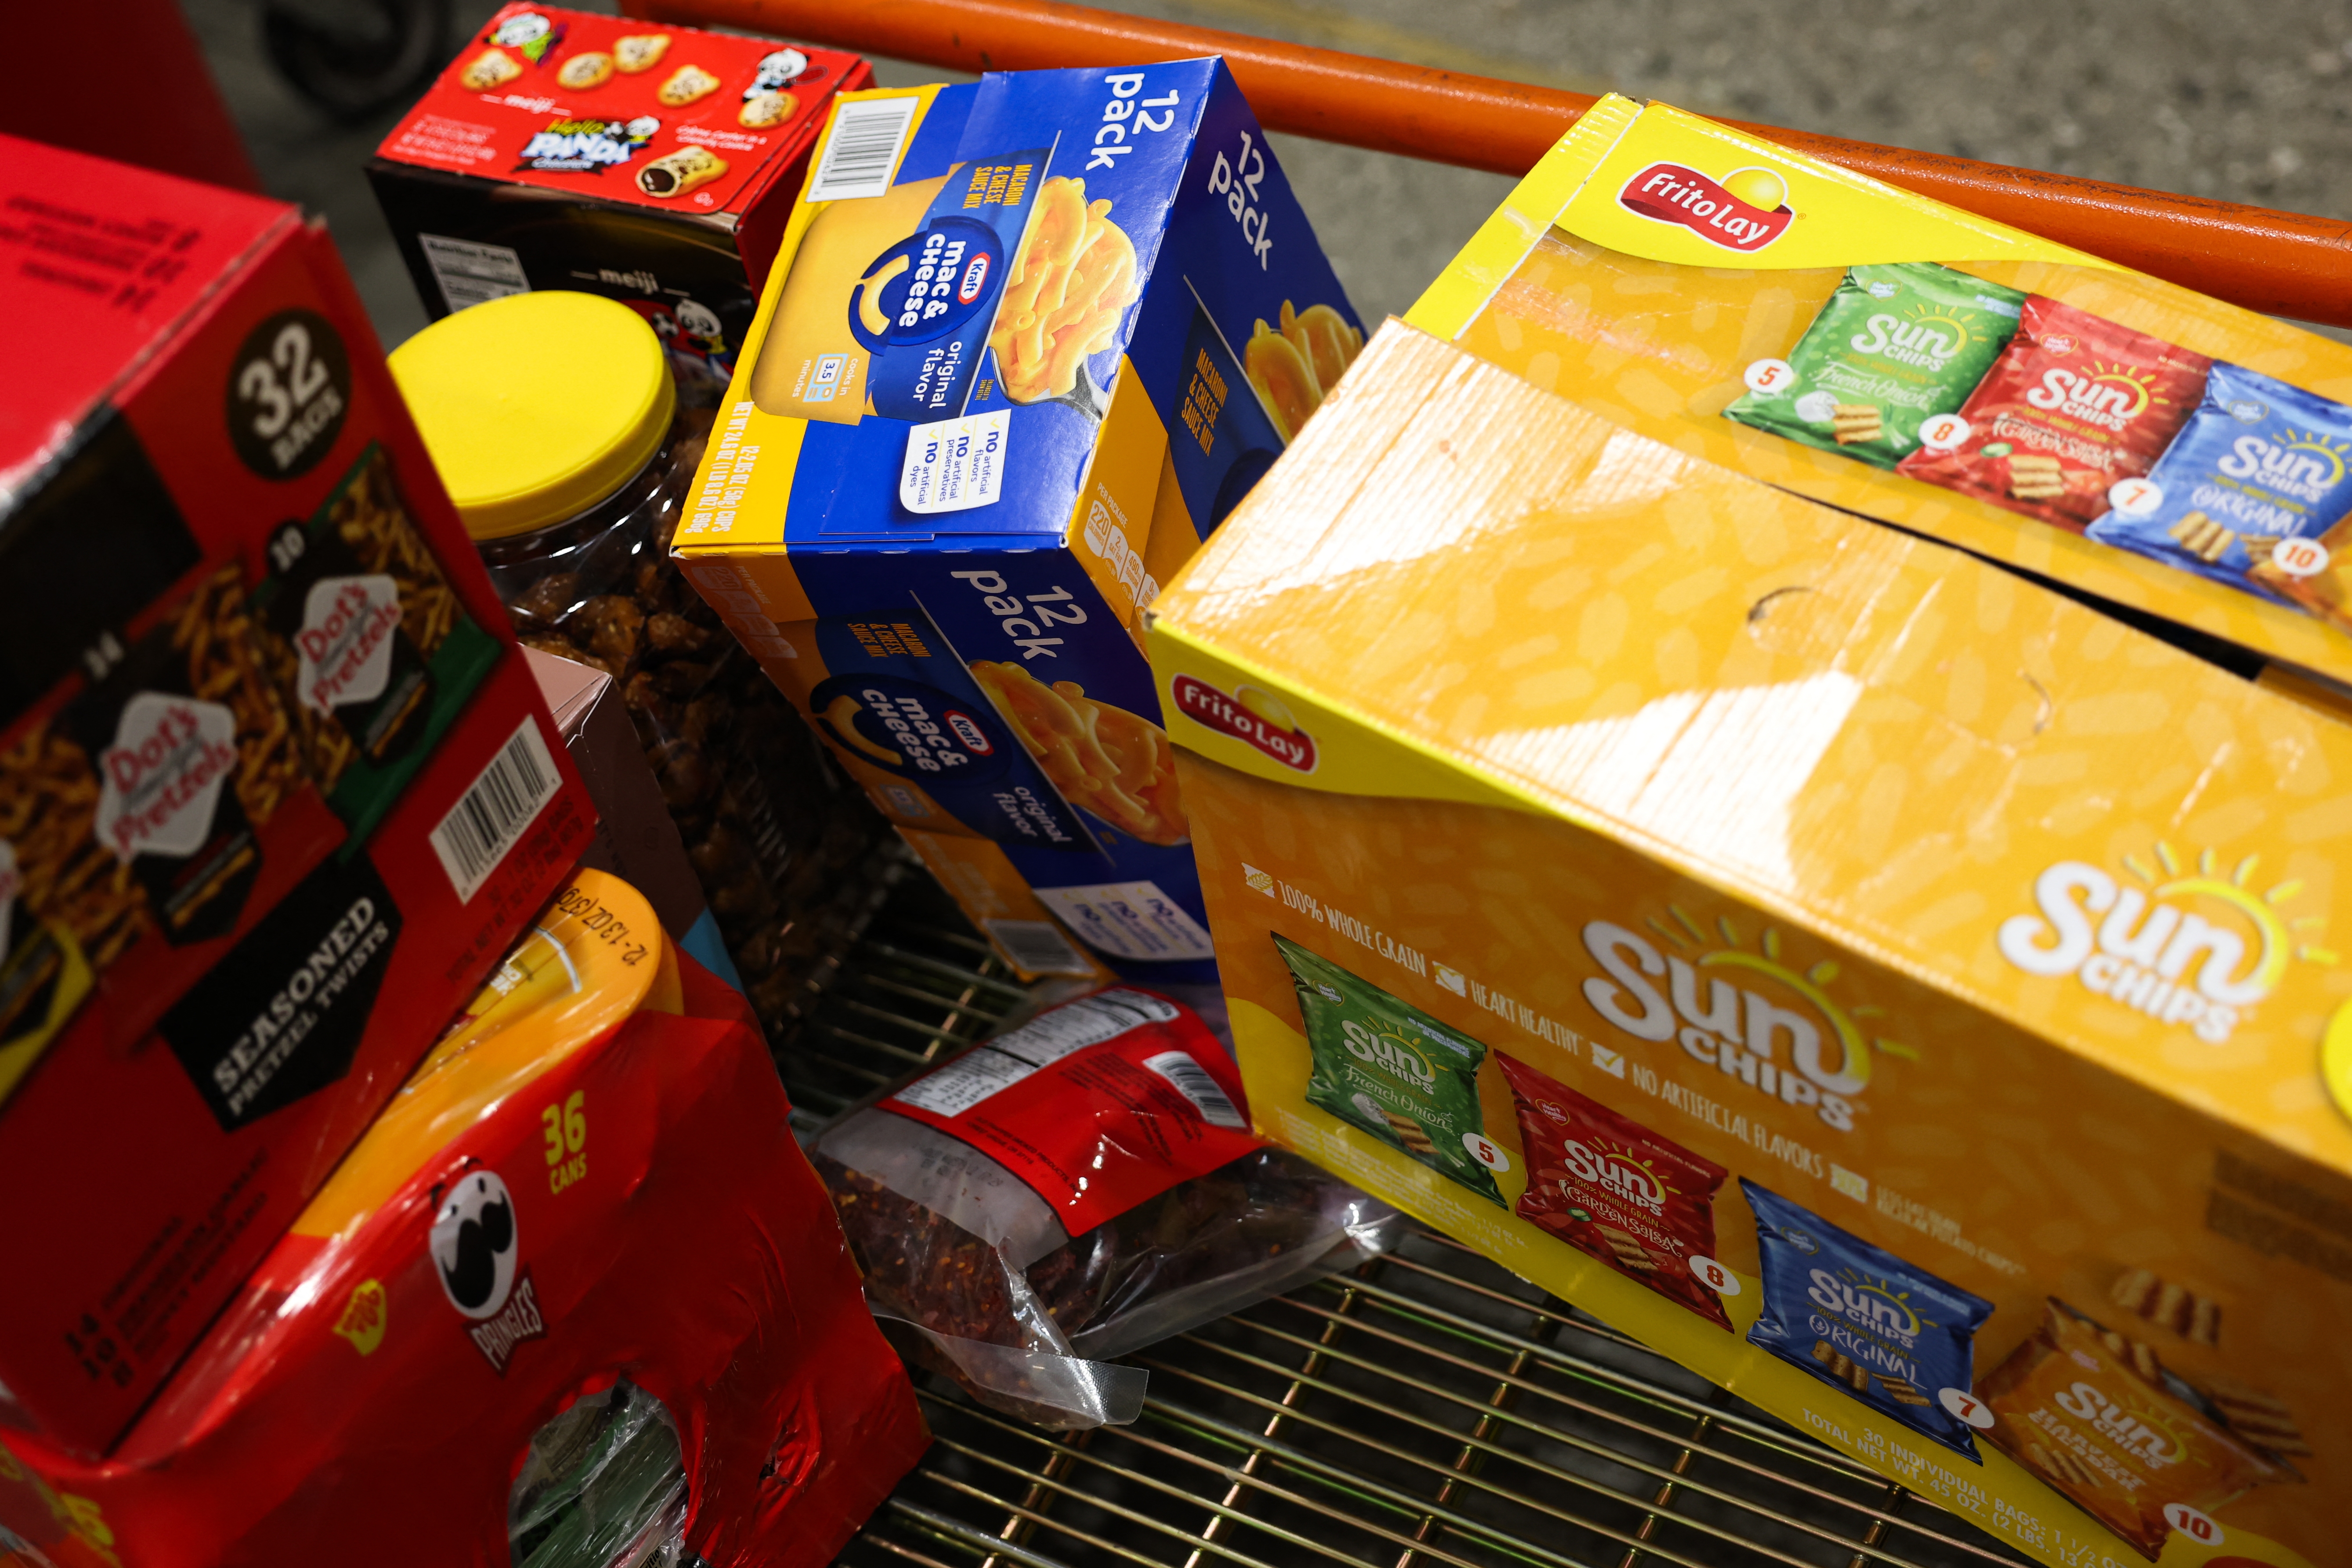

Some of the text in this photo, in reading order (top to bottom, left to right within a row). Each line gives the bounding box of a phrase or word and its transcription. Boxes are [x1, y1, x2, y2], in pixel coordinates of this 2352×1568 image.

[503, 94, 556, 114] meiji
[546, 118, 605, 134] Hello
[1086, 73, 1145, 171] pack
[1132, 89, 1180, 135] 12
[520, 132, 631, 164] PANDA
[1239, 130, 1265, 202] 12
[962, 166, 993, 209] SAUCE MIX
[983, 174, 1009, 204] CHEESE
[1002, 164, 1033, 206] MACARONI
[1641, 173, 1769, 245] Frito Lay
[1208, 150, 1273, 272] pack
[598, 268, 659, 294] meiji
[923, 241, 966, 320] mac &
[964, 263, 984, 293] Kraft
[1850, 313, 1967, 359] Sun
[1883, 345, 1945, 372] CHIPS
[238, 322, 328, 435] 32
[792, 359, 811, 397] minutes
[822, 362, 835, 379] 3.5
[839, 358, 859, 396] cooks in
[913, 348, 944, 401] flavor
[929, 341, 961, 408] original
[1196, 347, 1228, 407] MACARONI
[1758, 367, 1779, 385] 5
[1811, 361, 1929, 410] French Onion
[2027, 368, 2143, 419] Sun
[726, 417, 748, 430] WT
[732, 401, 755, 417] NET
[1189, 374, 1220, 429] & CHEESE
[2062, 401, 2127, 431] CHIPS
[720, 431, 743, 449] 24.6
[1181, 399, 1215, 457] SAUCE MIX
[1934, 421, 1954, 441] 8
[708, 470, 729, 481] LB
[715, 450, 736, 461] OZ
[910, 466, 921, 488] dyes
[918, 441, 939, 505] no artificial
[939, 439, 955, 502] preservatives
[949, 436, 970, 499] no artificial
[971, 449, 983, 482] flavors
[979, 431, 1000, 495] no artificial
[2218, 436, 2335, 489] Sun
[694, 496, 719, 511] OZ)
[703, 482, 724, 495] 8.6
[711, 445, 760, 532] 12-2.05 OZ (58g) CUPS
[1097, 482, 1128, 529] PER PACKAGE
[2124, 487, 2147, 506] 7
[2254, 470, 2322, 503] CHIPS
[684, 513, 713, 534] 696g
[1087, 520, 1105, 546] CALORIES
[1091, 504, 1110, 536] 220
[1126, 567, 1139, 589] SODIUM
[2285, 545, 2317, 567] 10
[299, 583, 369, 665] Dot's
[950, 570, 1065, 661] pack
[1026, 585, 1088, 628] 12
[312, 600, 403, 709] Pretzels
[847, 623, 889, 658] SAUCE MIX
[874, 629, 908, 655] CHEESE
[890, 623, 932, 657] MACARONI
[895, 697, 968, 766] mac &
[952, 719, 983, 748] Kraft
[1184, 684, 1305, 765] Frito Lay
[104, 707, 198, 794] Dot's
[113, 739, 233, 855] Pretzels
[994, 793, 1037, 838] flavor
[1015, 787, 1073, 842] original
[1278, 880, 1427, 977] 100% WHOLE GRAIN
[1998, 861, 2275, 1005] Sun
[623, 943, 649, 966] 12
[213, 897, 375, 1094] SEASONED
[229, 920, 388, 1116] PRETZEL TWISTS
[1470, 979, 1579, 1055] HEART HEALTHY
[1582, 920, 1869, 1095] Sun
[2079, 955, 2237, 1043] CHIPS
[1341, 1020, 1436, 1083] Sun
[1344, 1064, 1453, 1131] French Onion
[1353, 1058, 1432, 1106] 100% WHOLE GRAIN
[1376, 1057, 1434, 1095] CHIPS
[1679, 1027, 1854, 1132] CHIPS
[542, 1089, 586, 1165] 36
[1542, 1103, 1560, 1113] Heart
[1632, 1063, 1823, 1178] NO ARTIFICIAL FLAVORS
[550, 1152, 587, 1195] CANS
[1478, 1141, 1494, 1163] 5
[1564, 1139, 1666, 1205] Sun
[1573, 1178, 1658, 1228] 100% WHOLE GRAIN
[1600, 1178, 1662, 1217] CHIPS
[1707, 1265, 1724, 1286] 8
[470, 1277, 542, 1370] PRINGLES
[1808, 1268, 1920, 1337] Sun
[1809, 1314, 1928, 1390] ORIGINAL
[1816, 1306, 1909, 1359] 100% WHOLE GRAIN
[1846, 1308, 1913, 1349] CHIPS
[1958, 1396, 1976, 1418] 7
[2055, 1381, 2179, 1463] Sun
[2035, 1407, 2146, 1485] HARVEST
[2093, 1419, 2163, 1468] CHIPS
[1802, 1408, 2077, 1567] TOTAL NET WT. 45 OZ. (2 LBS. 13
[1864, 1428, 1884, 1448] 30
[1890, 1441, 1988, 1505] INDIVIDUAL
[1994, 1498, 2046, 1536] BAGS:
[2055, 1529, 2061, 1543] 1
[2178, 1510, 2212, 1539] 10
